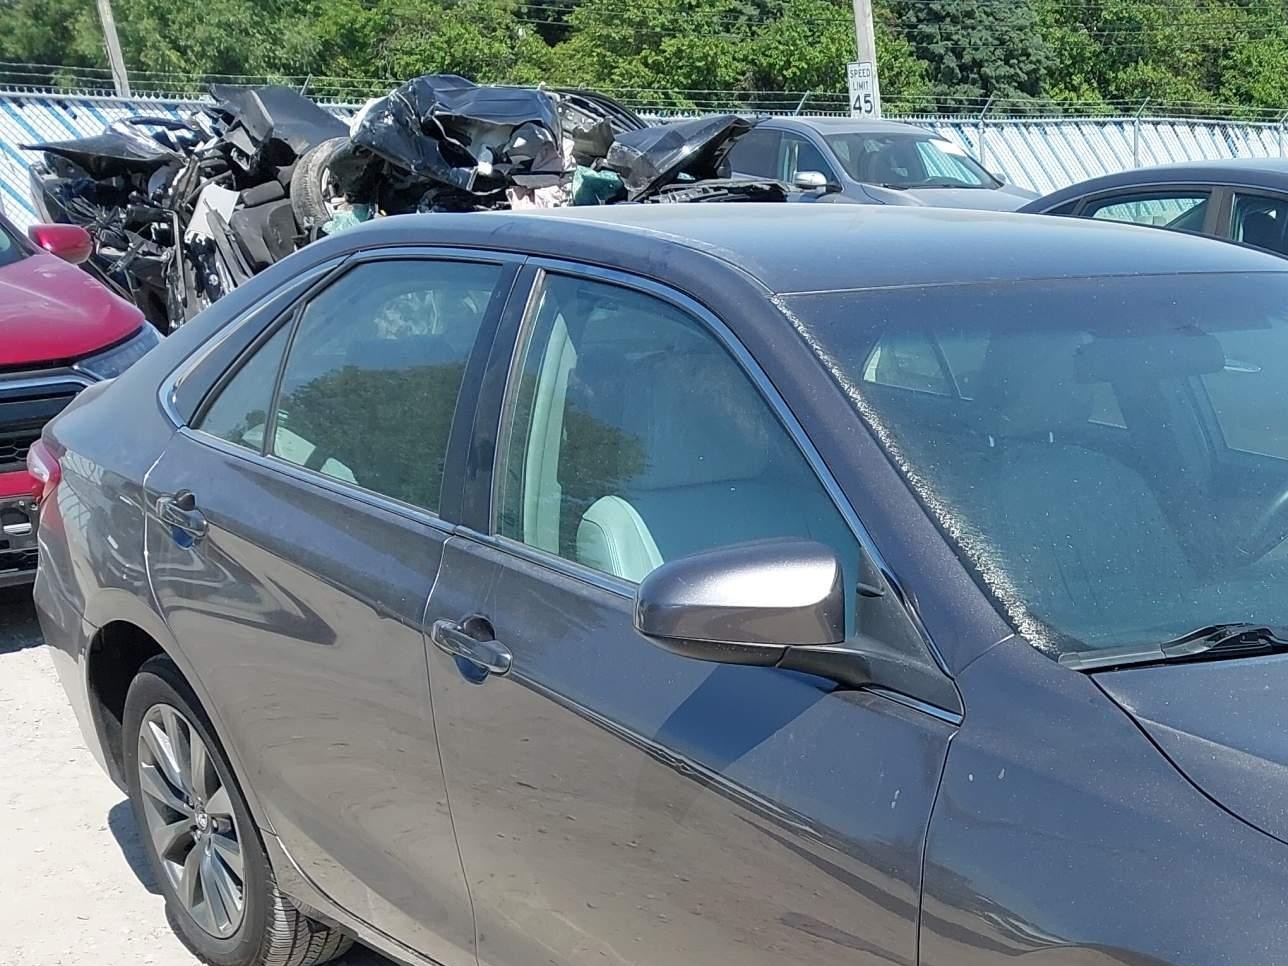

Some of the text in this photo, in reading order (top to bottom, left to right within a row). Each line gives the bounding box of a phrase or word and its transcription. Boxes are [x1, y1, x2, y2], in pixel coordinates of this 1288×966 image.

[849, 68, 871, 79] SPEED
[852, 81, 869, 91] LIMIT
[852, 94, 873, 114] 45
